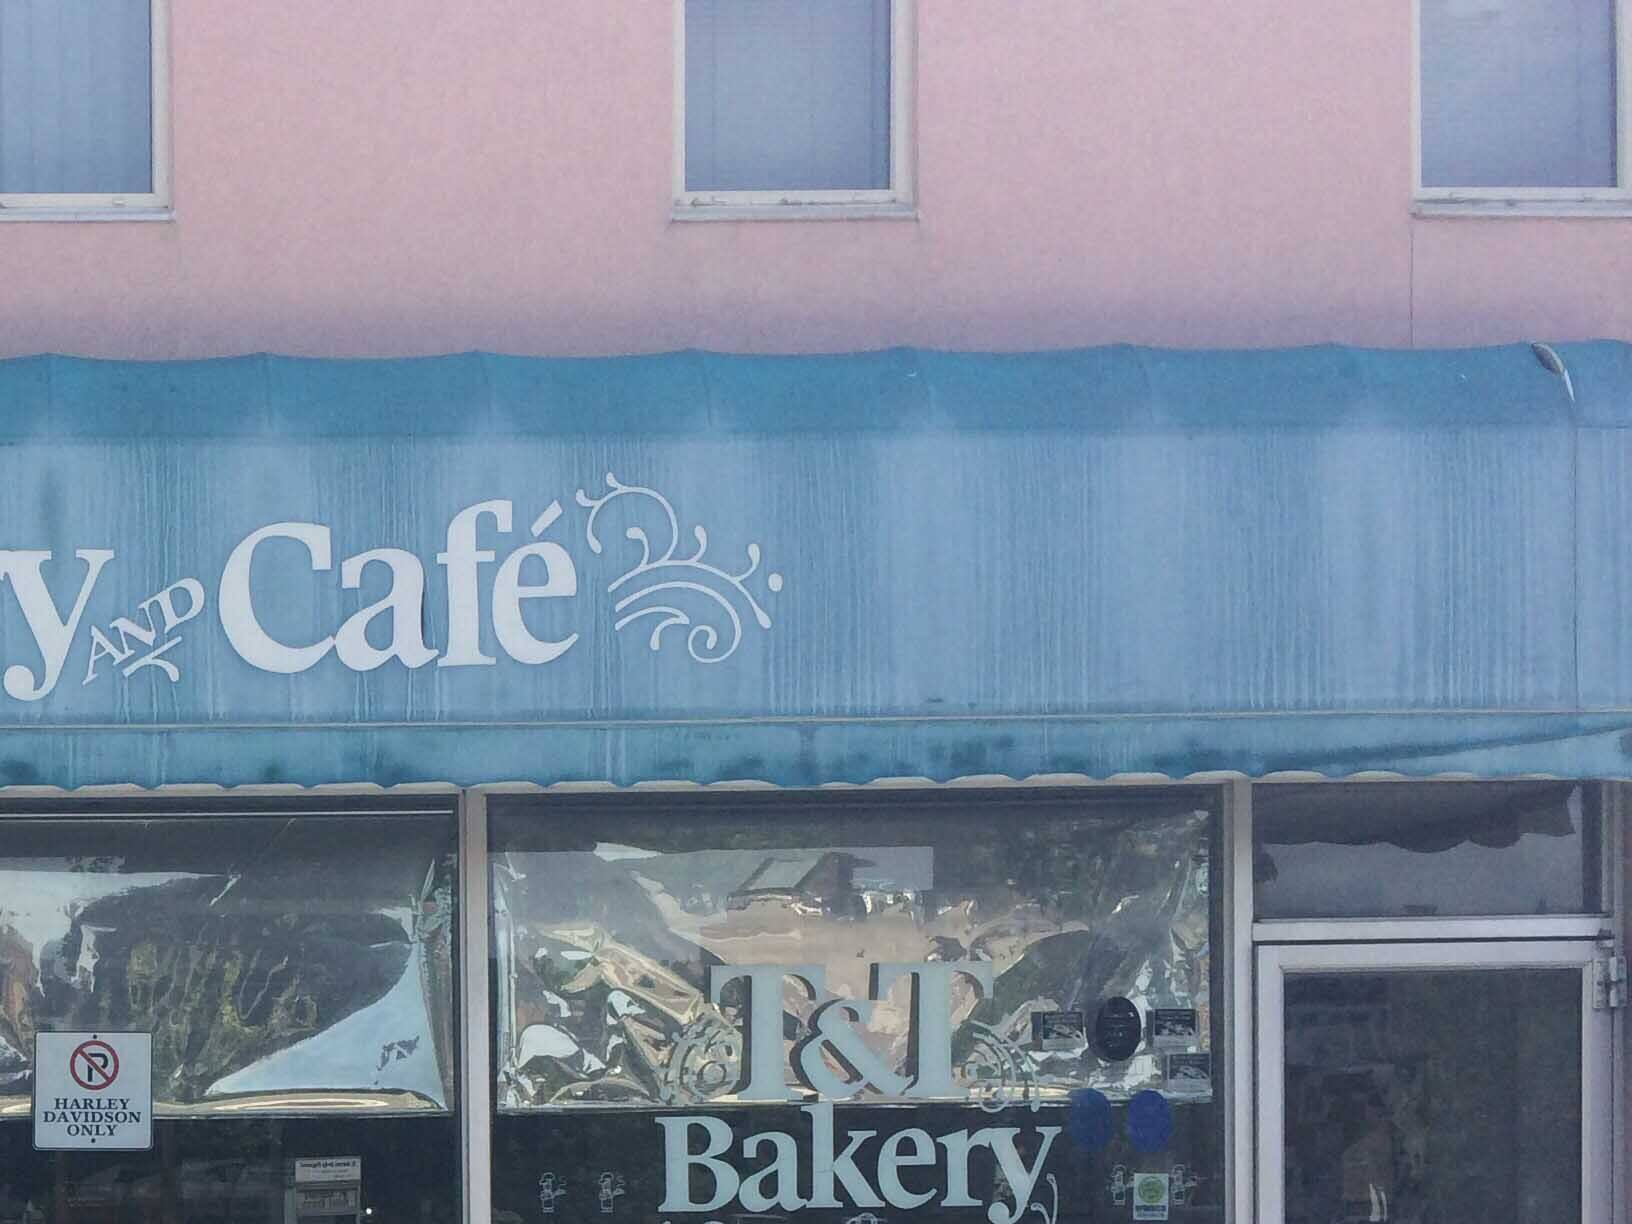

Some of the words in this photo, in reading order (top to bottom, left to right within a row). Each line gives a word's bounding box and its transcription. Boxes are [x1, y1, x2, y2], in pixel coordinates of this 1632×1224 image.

[82, 575, 206, 684] AND
[218, 498, 579, 674] Café
[704, 962, 995, 1102] T&T
[54, 1097, 130, 1110] HARLEY
[43, 1111, 142, 1123] DAVIDSON
[66, 1124, 117, 1136] ONLY
